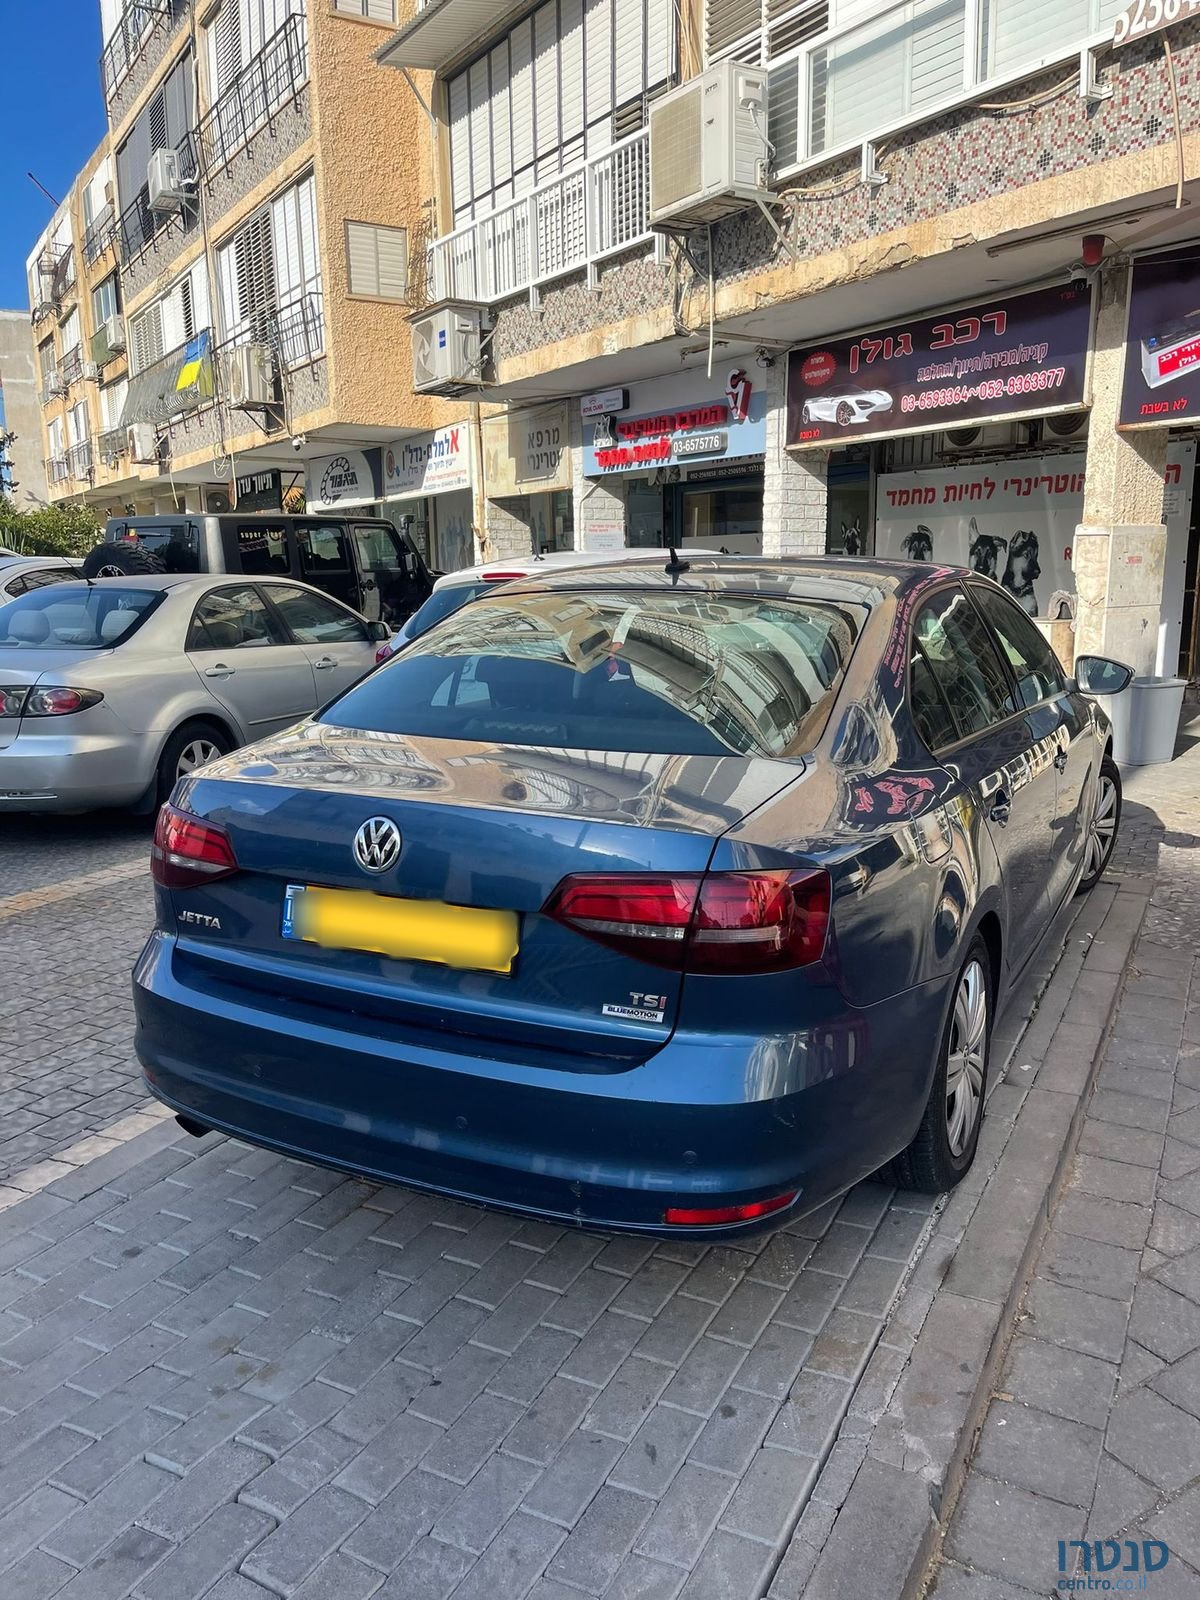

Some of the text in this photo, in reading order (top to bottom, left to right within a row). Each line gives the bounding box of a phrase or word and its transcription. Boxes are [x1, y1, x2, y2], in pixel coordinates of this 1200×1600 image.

[850, 310, 1007, 374] רכב גולן
[1160, 340, 1200, 363] יזרי רכב
[1178, 354, 1198, 368] גולן
[1140, 397, 1188, 415] לא בשבת
[528, 427, 560, 449] מרפא
[673, 435, 720, 453] 03-6575776
[527, 450, 560, 471] וטרינרי
[252, 473, 273, 495] תיווך
[943, 476, 996, 503] לחיות
[886, 487, 937, 507] מחמד
[178, 910, 222, 930] JETTA
[629, 991, 668, 1010] TSI
[607, 1005, 658, 1019] BLUEMOTION
